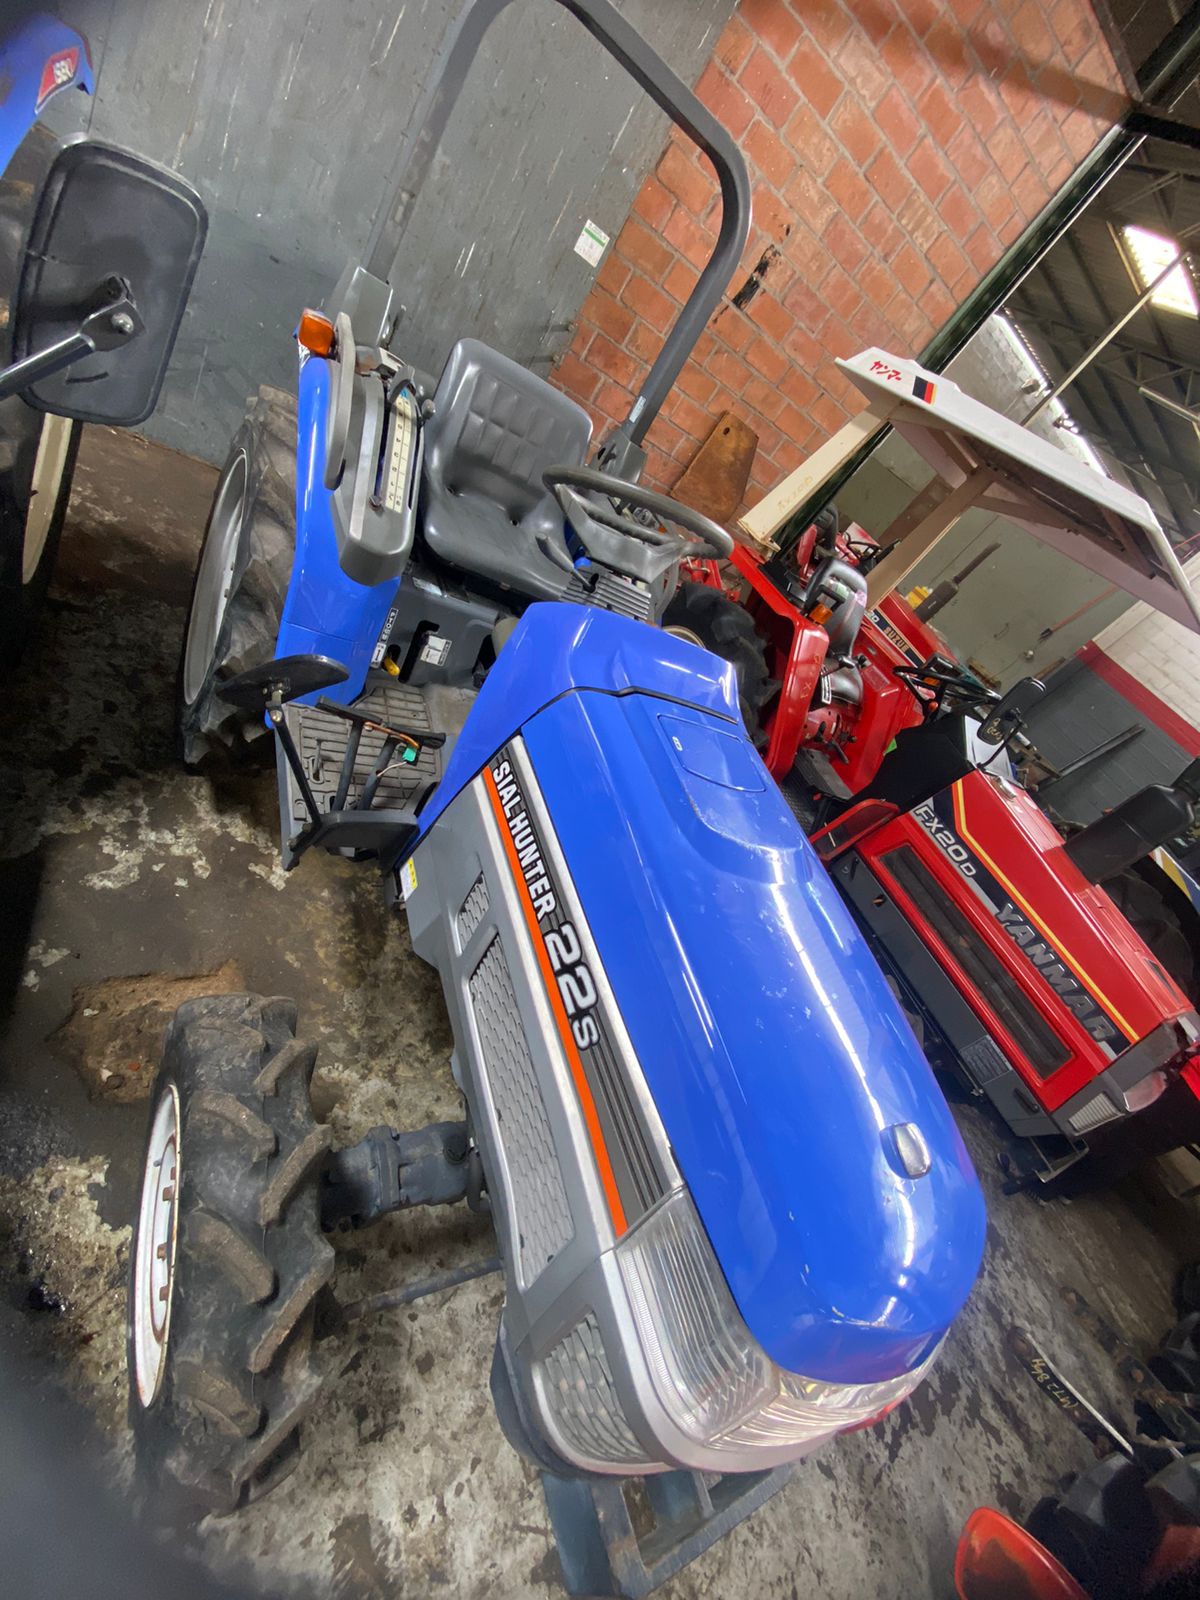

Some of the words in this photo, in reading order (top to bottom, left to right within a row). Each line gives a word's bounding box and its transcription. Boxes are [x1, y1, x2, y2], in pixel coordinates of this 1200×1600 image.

[870, 361, 902, 381] ヤンマー
[883, 626, 910, 653] SUZUE
[994, 902, 1116, 1043] YANMAR
